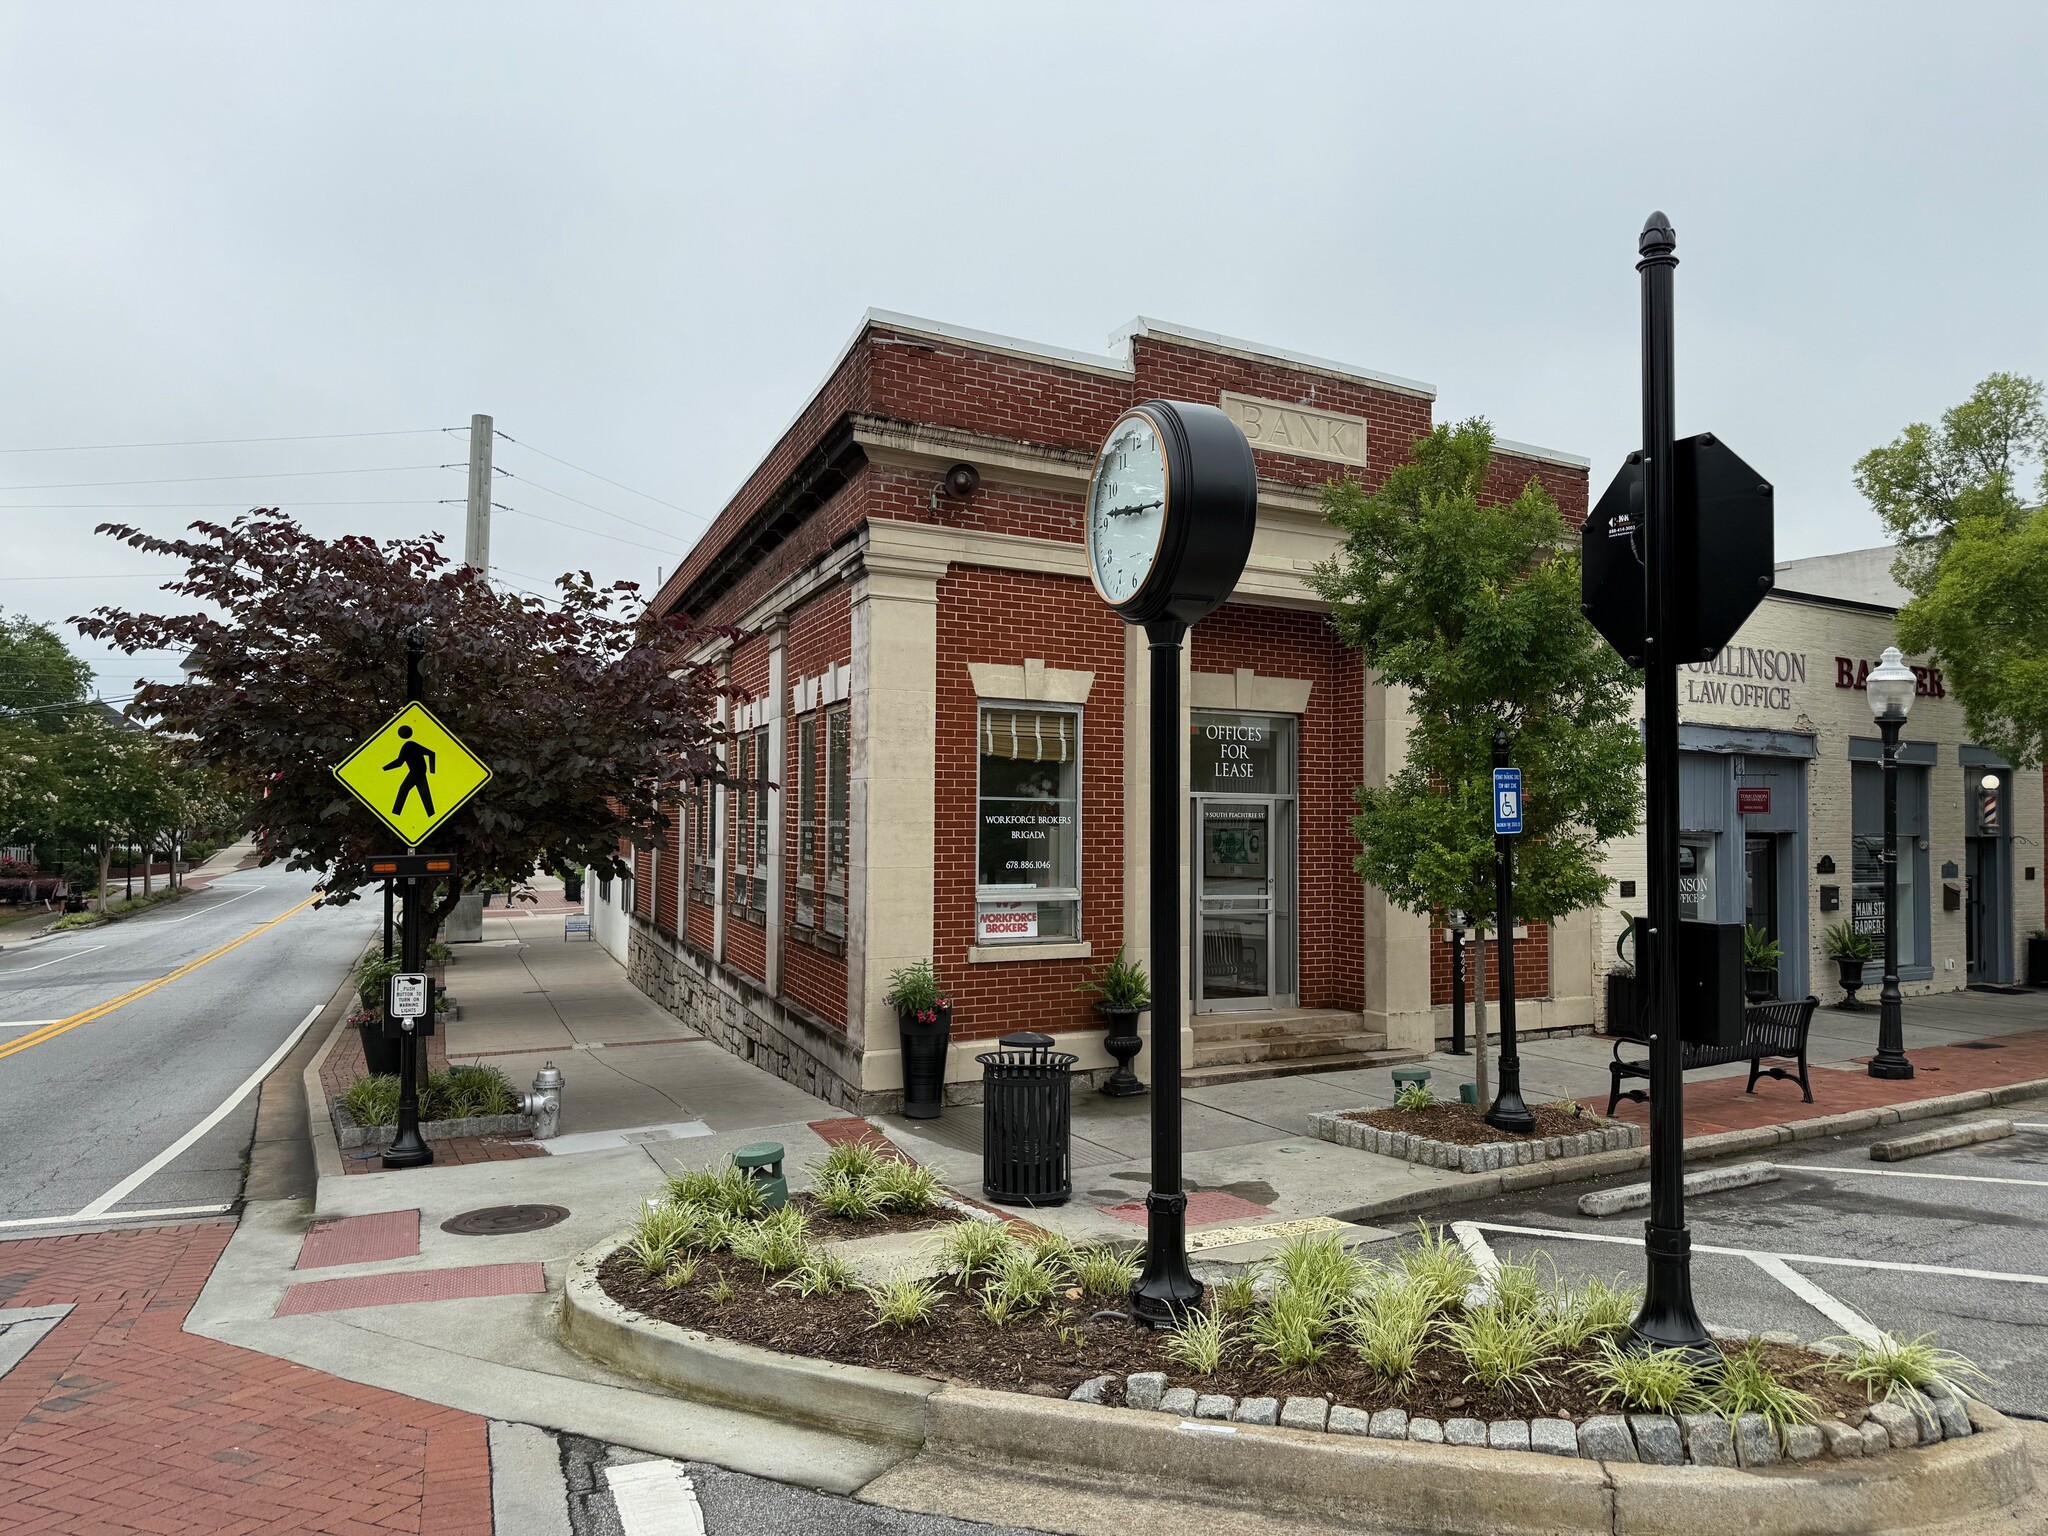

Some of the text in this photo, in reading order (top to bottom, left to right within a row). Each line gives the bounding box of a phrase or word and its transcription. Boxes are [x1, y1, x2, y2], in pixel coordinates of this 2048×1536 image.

[1240, 403, 1347, 457] BANK
[1131, 432, 1142, 452] 12
[1150, 435, 1156, 452] 1
[1118, 452, 1128, 472] 11
[1107, 481, 1118, 500] 10
[1103, 516, 1109, 533] 9
[1107, 547, 1113, 564] 8
[1117, 569, 1123, 586] 7
[1131, 571, 1138, 589] 6
[1835, 656, 1945, 699] BAER
[1688, 679, 1791, 710] LAW OFFICE
[1206, 724, 1262, 742] OFFICES
[1220, 744, 1250, 759] FOR
[1215, 762, 1254, 778] LEASE
[985, 815, 1072, 825] WORKFORCE BROKERS
[1011, 830, 1046, 839] BRIGADA
[1005, 860, 1051, 869] 678.886.1046
[1680, 878, 1708, 892] NSON
[1855, 902, 1885, 916] MAIN STR
[980, 912, 1037, 924] WORKFORCE
[985, 923, 1029, 934] BROKERS
